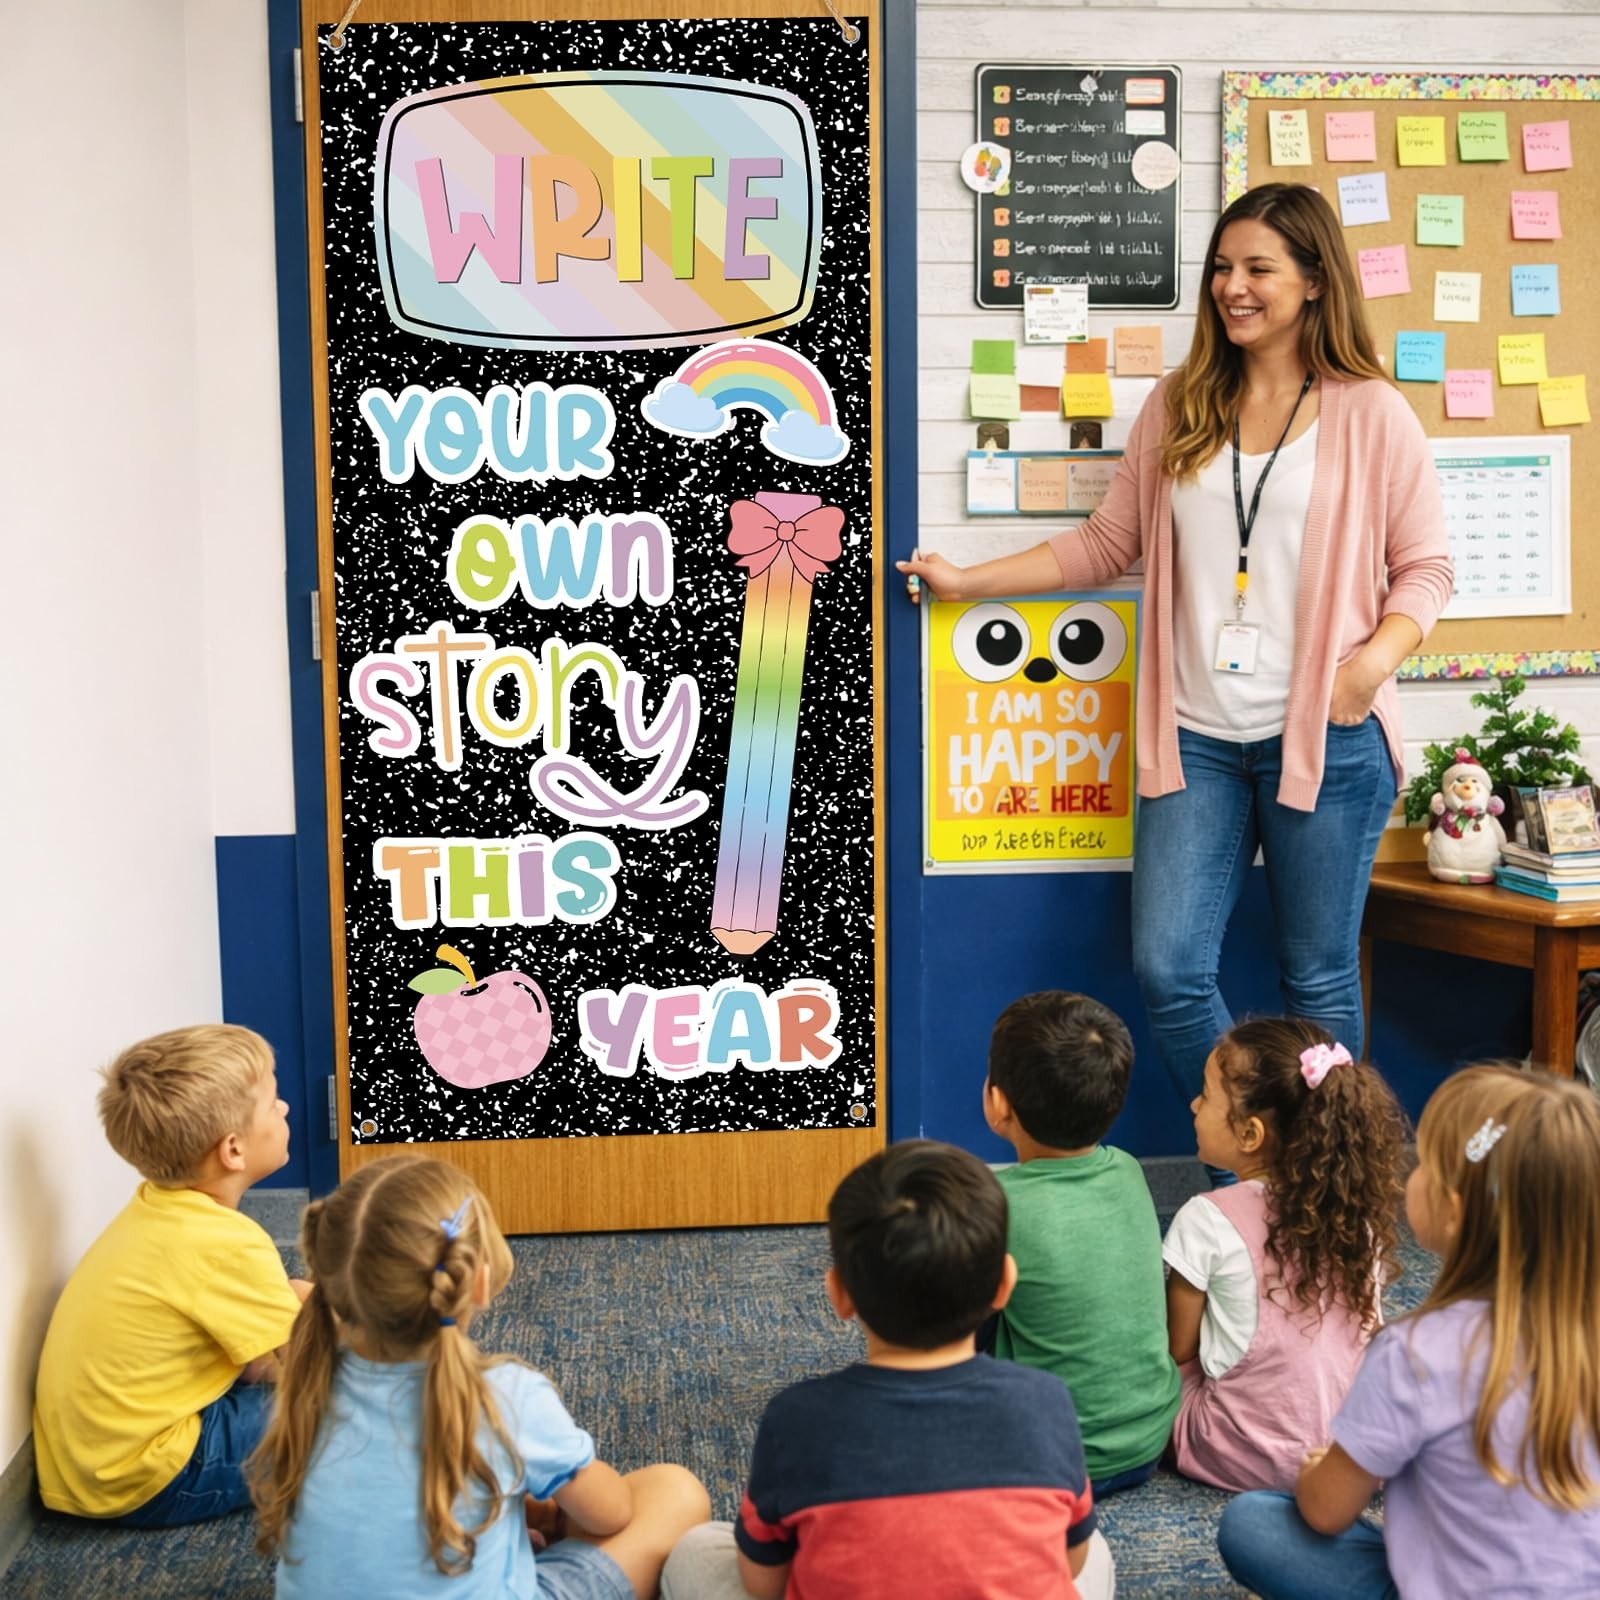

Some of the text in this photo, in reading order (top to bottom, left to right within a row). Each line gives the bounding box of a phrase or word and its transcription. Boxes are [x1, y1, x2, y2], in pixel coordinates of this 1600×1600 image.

[415, 154, 783, 284] WRITE
[365, 390, 609, 476] YOUR
[965, 688, 1101, 724] I AM SO
[948, 728, 1122, 785] HAPPY
[948, 785, 984, 815] TO
[1051, 784, 1113, 813] HERE
[381, 839, 613, 922] THIS
[585, 984, 836, 1069] YEAR
